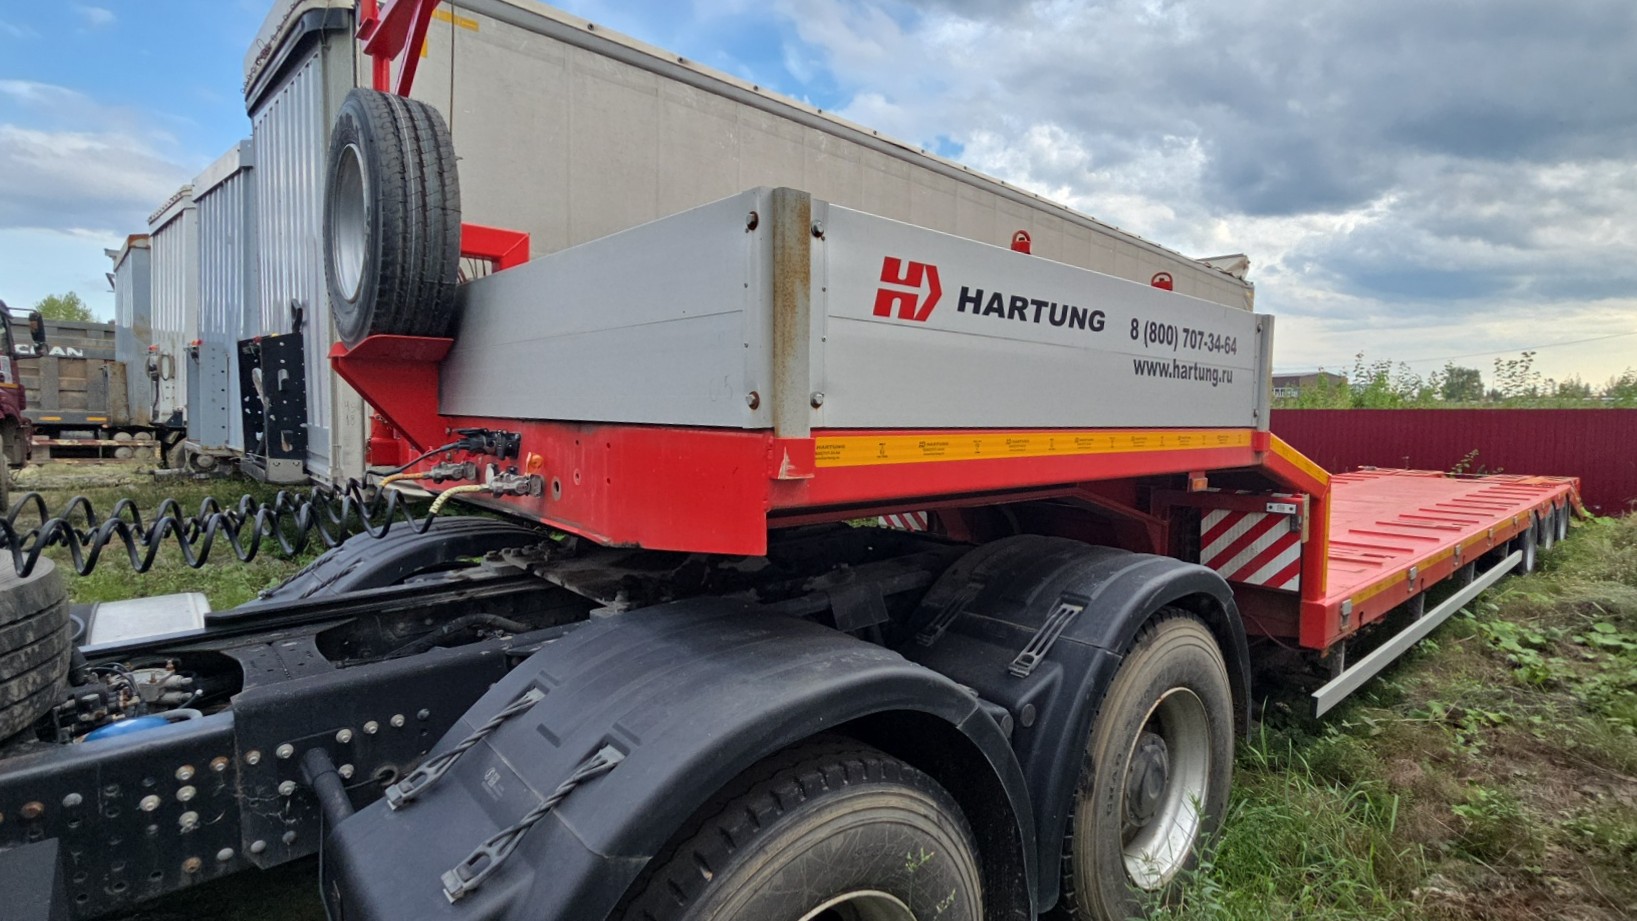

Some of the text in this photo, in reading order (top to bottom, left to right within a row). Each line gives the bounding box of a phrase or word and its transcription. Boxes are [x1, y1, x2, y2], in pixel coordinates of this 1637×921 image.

[957, 285, 1105, 332] HARTUNG
[1130, 318, 1237, 355] 8 (800) 707-34-64
[1133, 359, 1233, 387] www.hartung.ru
